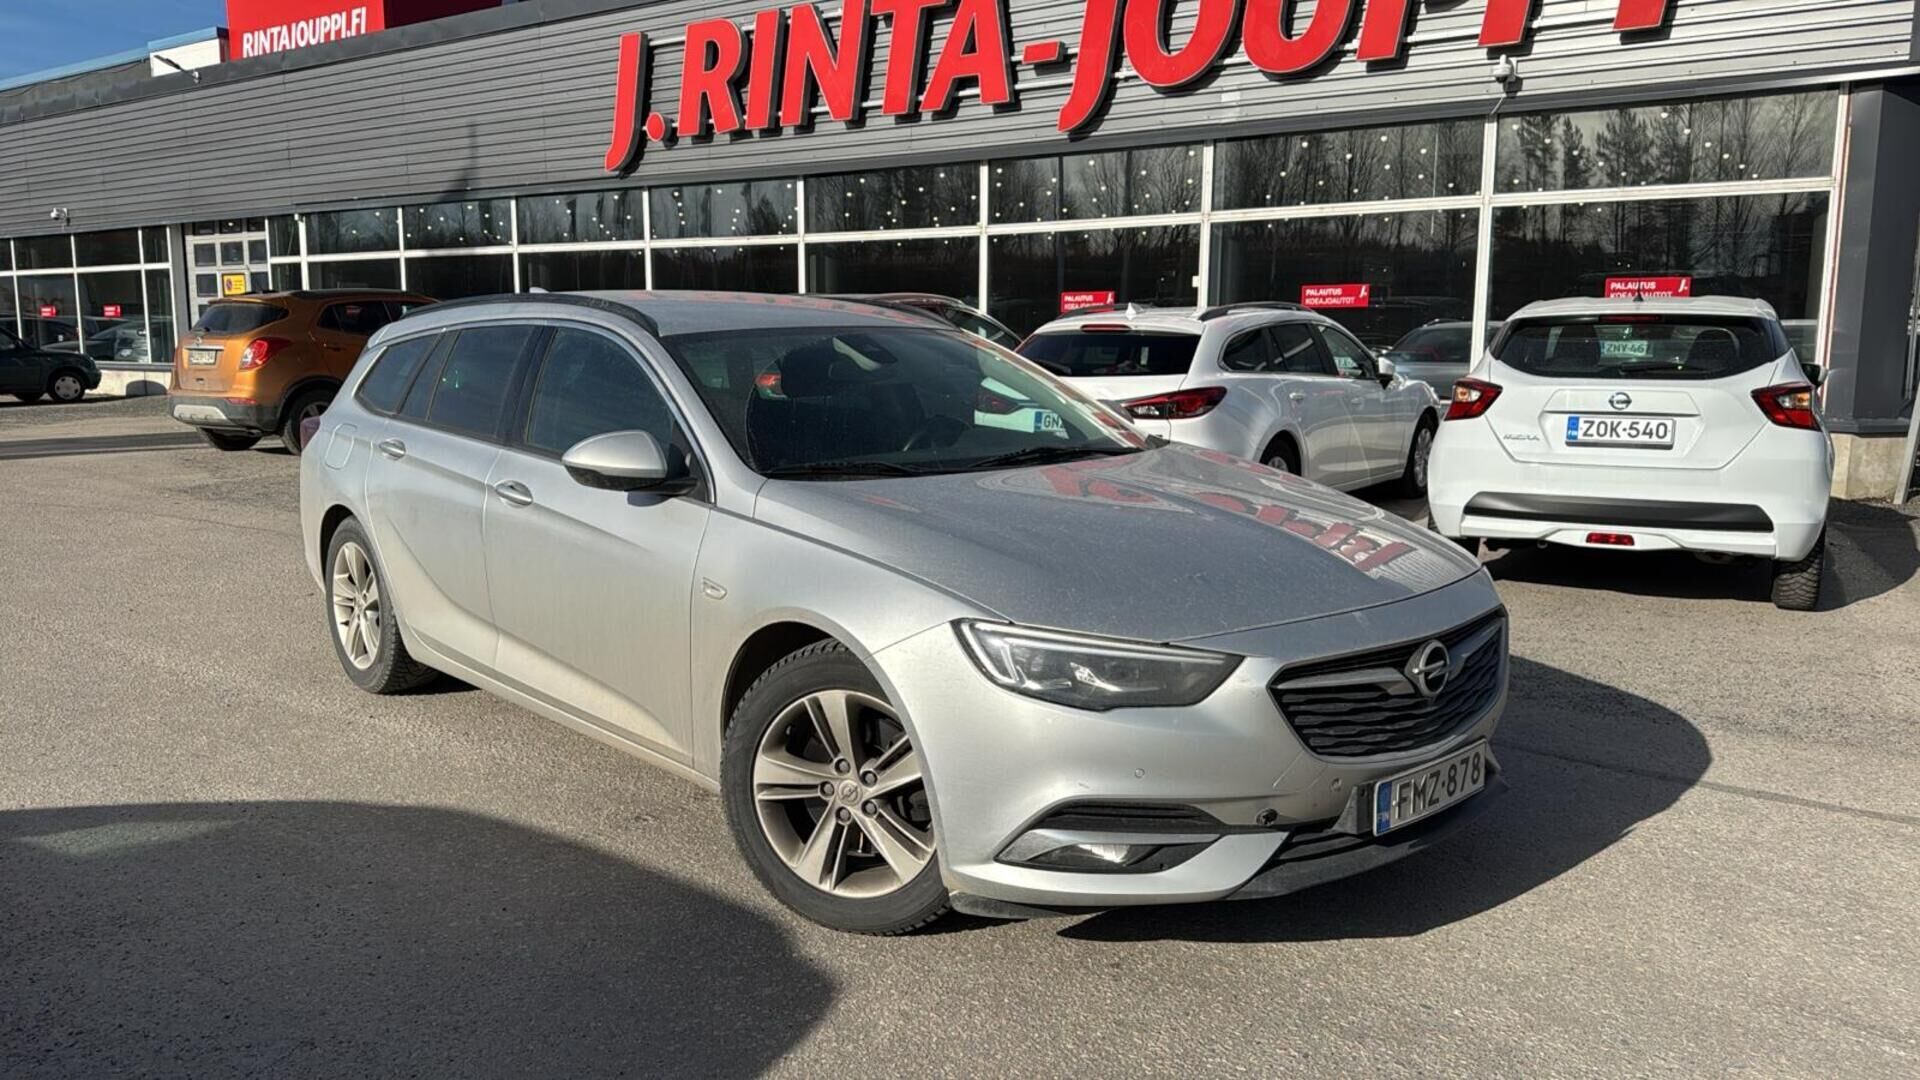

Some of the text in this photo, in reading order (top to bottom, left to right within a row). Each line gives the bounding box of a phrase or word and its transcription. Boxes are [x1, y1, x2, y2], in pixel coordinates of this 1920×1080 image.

[1305, 288, 1343, 296] PALAUTUS
[1610, 281, 1656, 290] PALAUTUS
[1582, 420, 1668, 439] ZOK-540
[1395, 752, 1481, 819] FMZ-878
